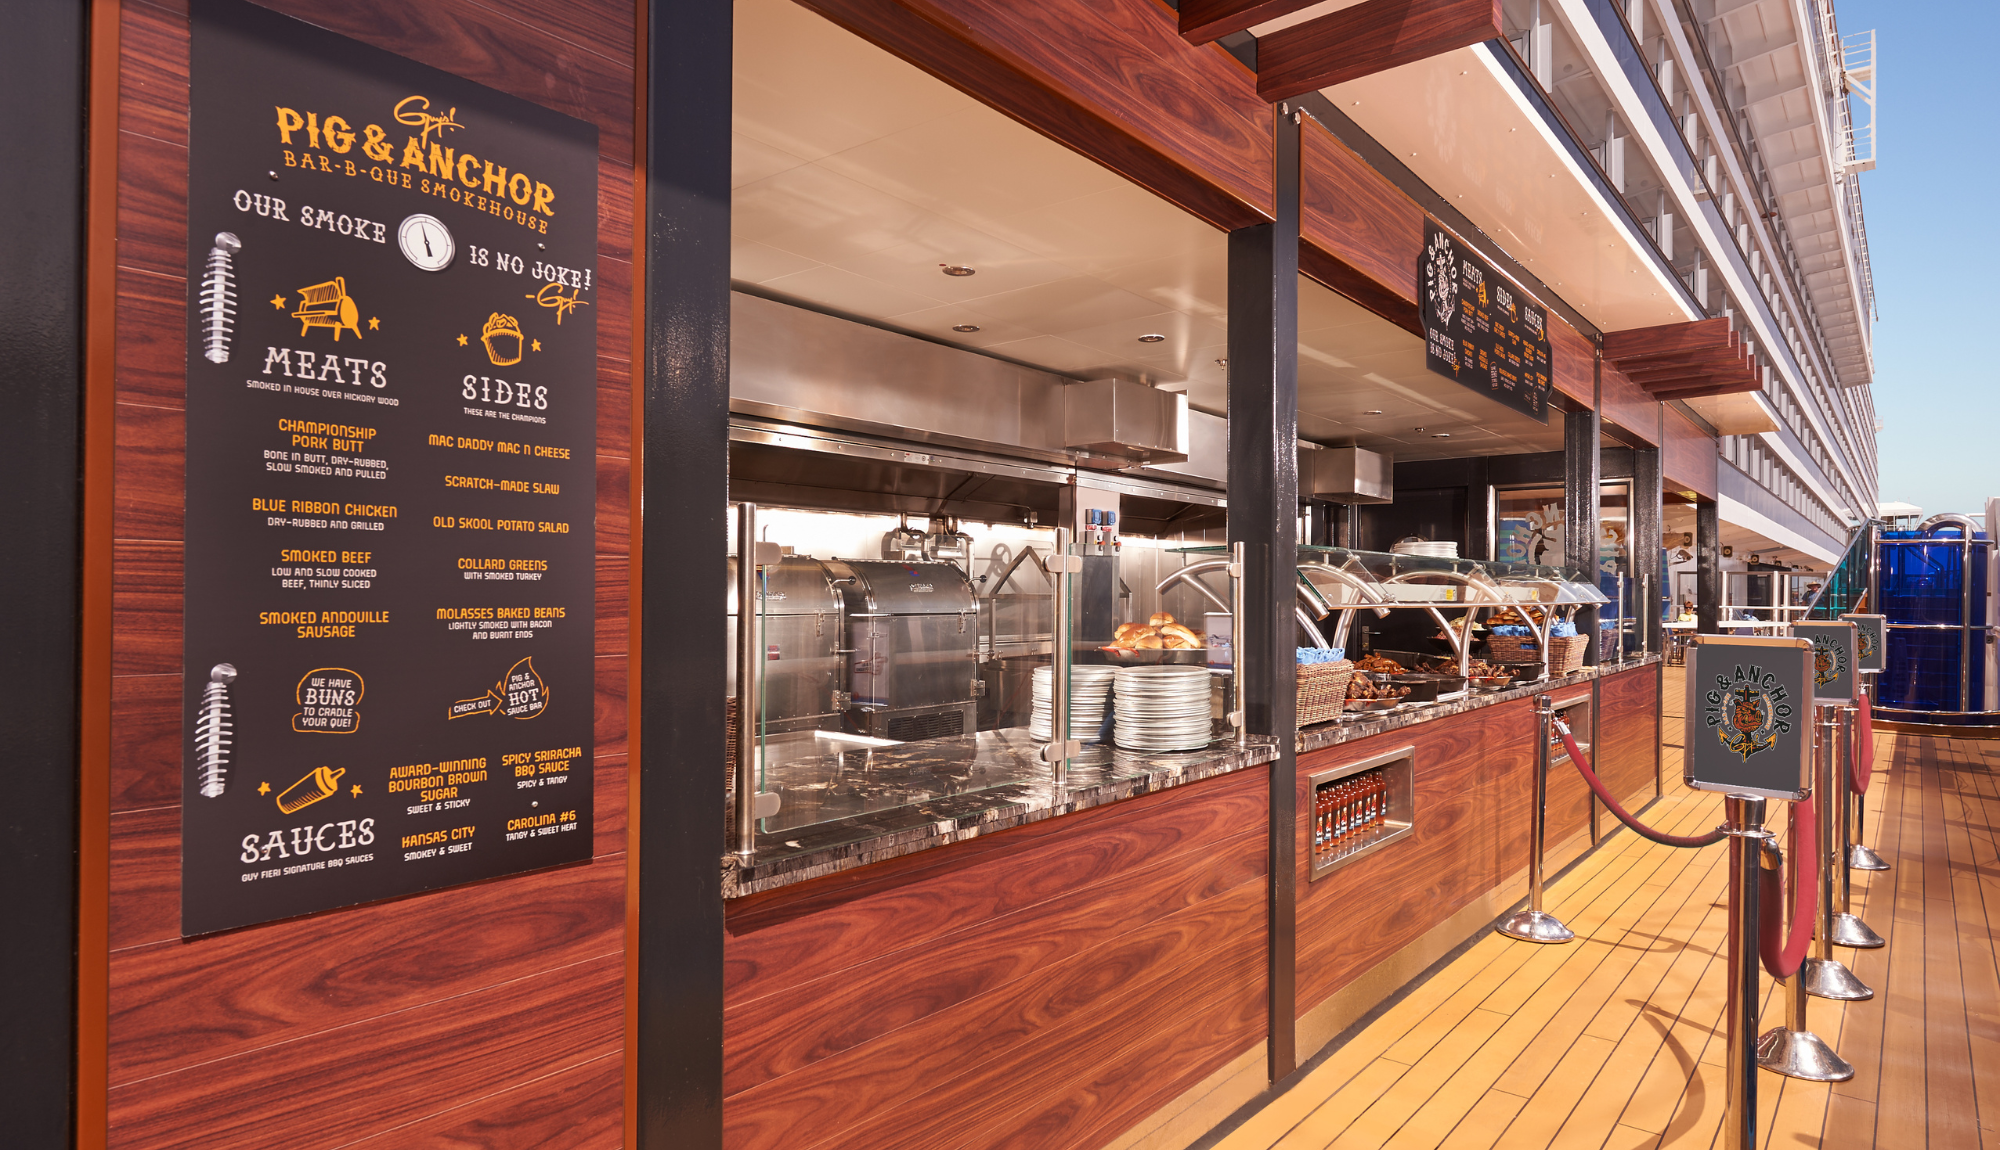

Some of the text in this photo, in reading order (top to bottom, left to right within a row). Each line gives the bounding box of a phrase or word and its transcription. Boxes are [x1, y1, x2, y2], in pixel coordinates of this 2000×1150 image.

[275, 106, 555, 217] PIG & ANCHOR
[283, 150, 548, 234] BAR-B-QUE SMOKEHOUSE
[233, 190, 591, 290] OUR SMOKE IS NO JOKE!
[1434, 231, 1458, 295] ANCHOR
[1462, 259, 1483, 284] MEATS
[263, 347, 386, 388] MEATS
[247, 380, 281, 391] SMOKED
[294, 386, 319, 396] HOUSE
[322, 390, 342, 399] OVER
[344, 393, 375, 402] HICKORY
[378, 397, 399, 406] WOOD
[462, 375, 547, 410] SIDES
[464, 407, 483, 416] THESE
[485, 410, 496, 418] ARE
[512, 414, 546, 424] CHAMPIONS
[279, 419, 376, 439] CHAMPIONSHIP
[292, 435, 364, 452] PORK BUTT
[429, 434, 570, 459] MAC DADDY MAC N CHEESE
[264, 450, 388, 470] BONE IN BUTT, DRY-RUBBED,
[266, 462, 386, 479] SLOW SMOKED AND PULLED
[445, 475, 560, 495] SCRATCH-MADE SLAW
[253, 498, 397, 518] BLUE RIBBON CHICKEN
[268, 517, 384, 531] DRY-RUBBED AND GRILLED
[433, 516, 569, 533] OLD SKOOL POTATO SALAD
[281, 550, 371, 563] SMOKED BEEF
[458, 558, 548, 571] COLLARD GREENS
[272, 568, 377, 577] LOW AND SLOW COOKED
[484, 572, 514, 580] SMOKED
[282, 579, 370, 589] BEEF, THINLY SLICED
[260, 611, 389, 624] SMOKED ANDOUILLE
[437, 607, 566, 619] MOLASSES BAKED BEANS
[297, 625, 355, 638] SAUSAGE
[449, 622, 477, 630] LIGHTLY
[479, 621, 508, 629] SMOKED
[530, 620, 552, 628] BACON
[490, 631, 513, 639] BURNT
[1815, 634, 1847, 673] ANCHOR
[312, 678, 352, 688] WE HAVE
[509, 680, 535, 691] ANCHOR
[305, 688, 355, 706] BUNS
[508, 688, 539, 707] HOT
[1705, 690, 1722, 728] PIG
[1716, 674, 1733, 691] &
[1734, 664, 1792, 734] ANCHOR
[304, 707, 353, 717] TO CRADLE
[454, 700, 491, 713] CHECK OUT
[507, 702, 542, 715] SAUCE BAR
[302, 718, 351, 728] YOUR QUE!
[502, 747, 582, 766] SPICY SRIRACHA
[390, 757, 486, 779] AWARD-WINNING
[515, 760, 569, 777] BBQ SAUCE
[389, 770, 487, 793] BOURBON BROWN
[517, 780, 537, 789] SPICY
[547, 776, 567, 785] TANGY
[420, 787, 458, 802] SUGAR
[407, 799, 470, 815] SWEET & STICKY
[507, 810, 576, 831] CAROLINA #6
[402, 826, 475, 848] KANSAS CITY
[506, 822, 577, 841] TANGY & SWEET HEAT
[241, 818, 374, 864] SAUCES
[404, 842, 472, 861] SMOKEY & SWEET
[242, 853, 374, 882] GUY FIERI SIGNATURE BBQ SAUCES
